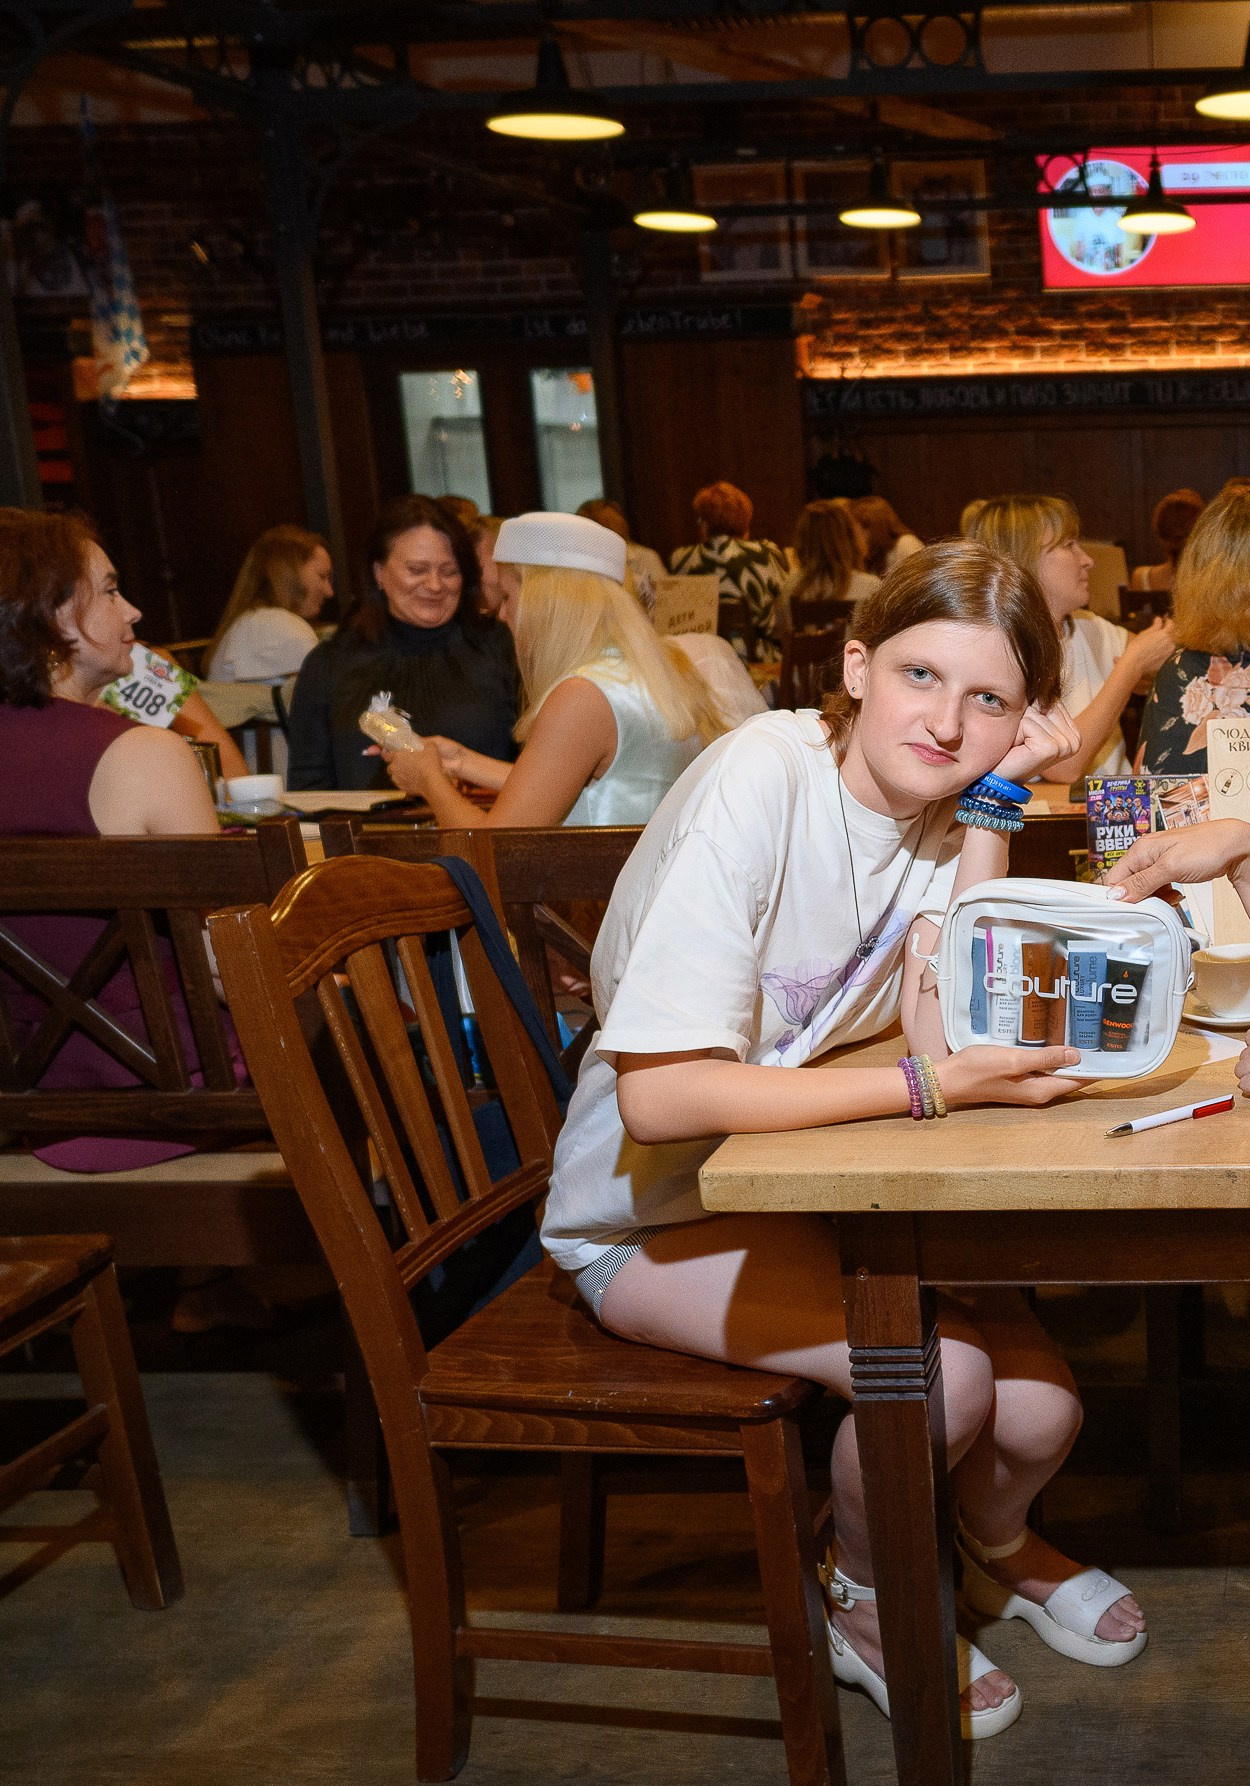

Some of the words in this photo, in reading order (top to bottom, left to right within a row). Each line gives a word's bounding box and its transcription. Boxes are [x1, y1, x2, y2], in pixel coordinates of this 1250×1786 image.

[120, 680, 167, 716] 408
[1088, 779, 1103, 791] 17
[1096, 824, 1134, 839] РУКИ
[983, 972, 1138, 1004] couture
